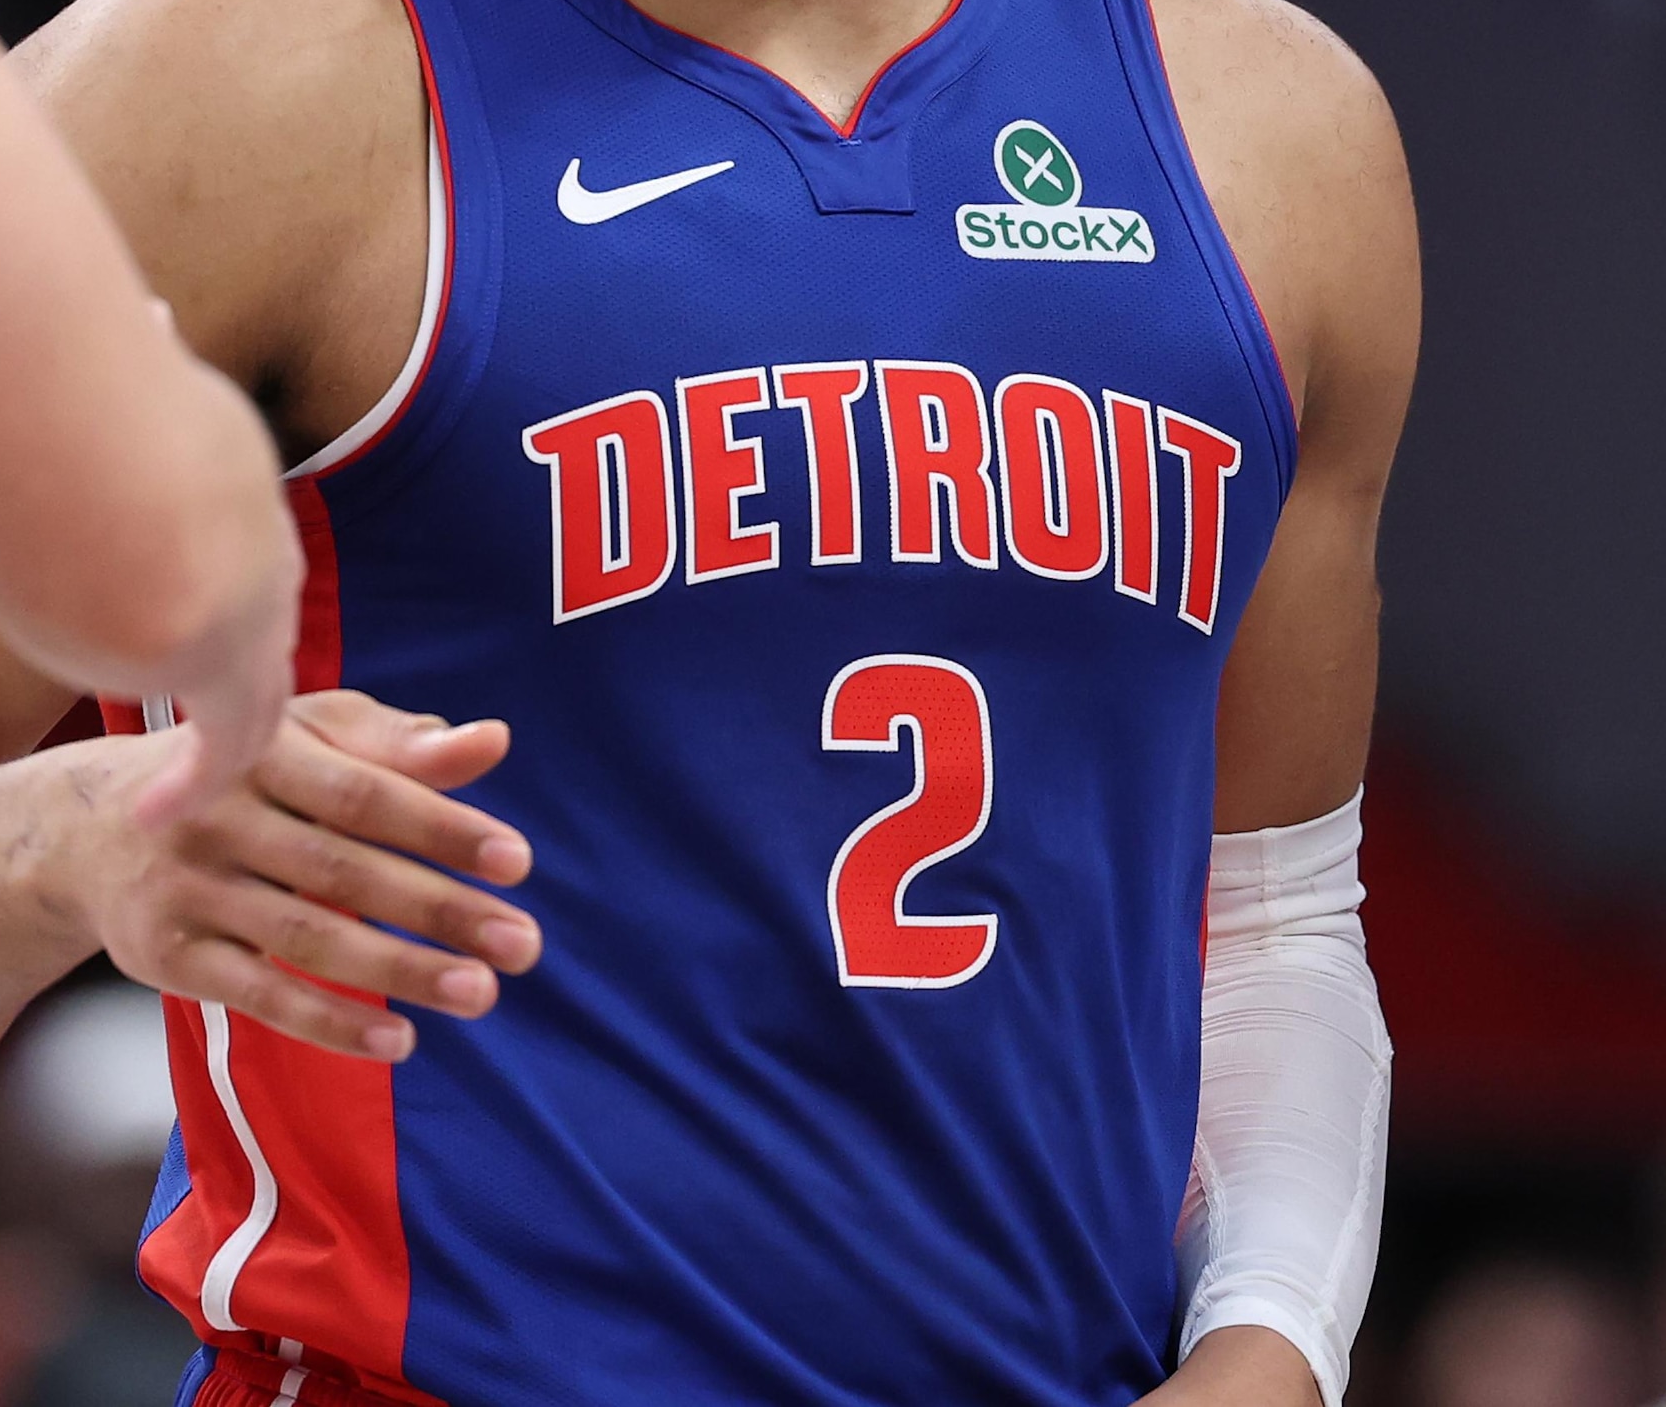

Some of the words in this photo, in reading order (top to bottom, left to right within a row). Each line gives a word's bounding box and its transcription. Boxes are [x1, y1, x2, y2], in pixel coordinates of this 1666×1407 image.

[963, 210, 1148, 256] StockX
[522, 359, 1242, 636] DETROIT
[822, 653, 998, 989] 2
